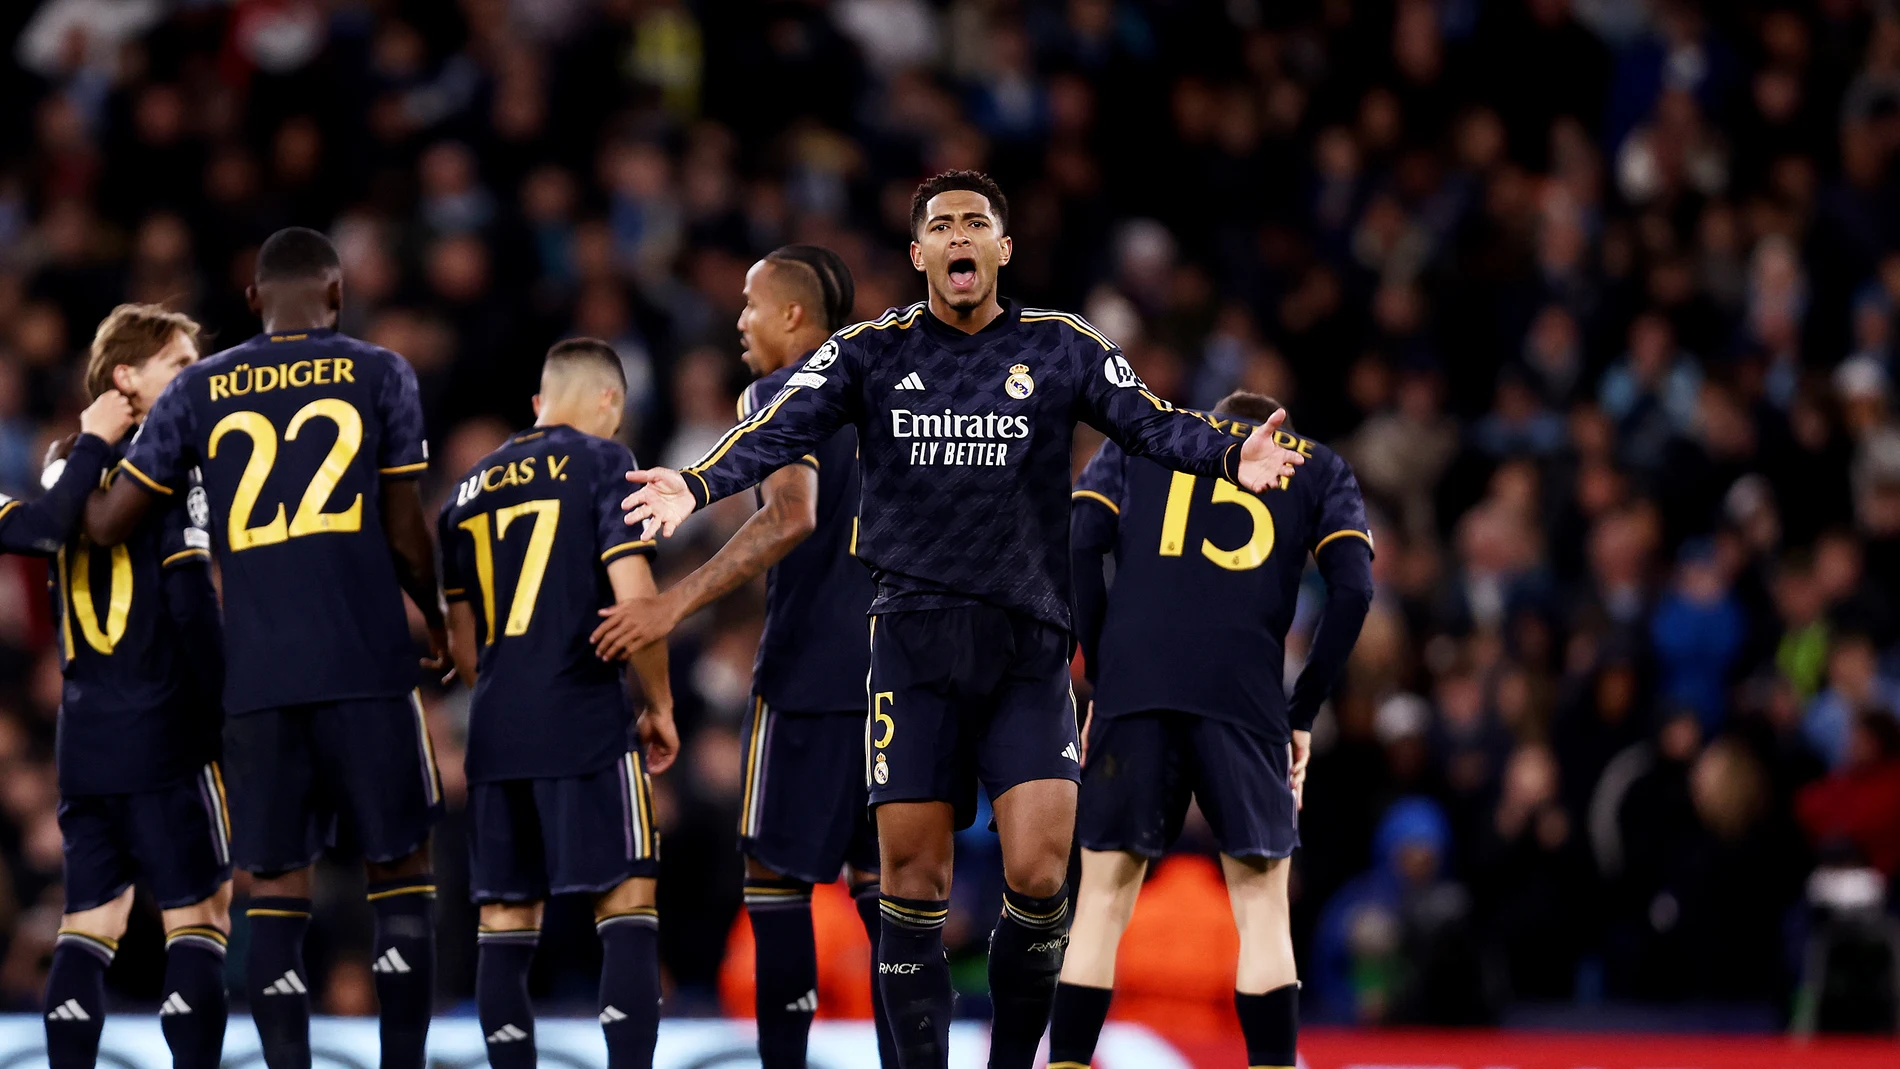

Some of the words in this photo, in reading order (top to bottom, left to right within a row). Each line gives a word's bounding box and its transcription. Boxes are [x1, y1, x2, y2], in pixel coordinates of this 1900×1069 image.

[208, 357, 356, 402] RÜDIGER
[890, 408, 1030, 439] Emirates
[207, 398, 363, 552] 22
[456, 456, 537, 508] LUCAS
[546, 454, 570, 482] V.
[910, 441, 940, 467] FLY
[943, 442, 1008, 467] BETTER
[1158, 465, 1290, 572] 15
[457, 498, 562, 647] 17
[874, 690, 896, 750] 5
[878, 961, 924, 975] RMCF
